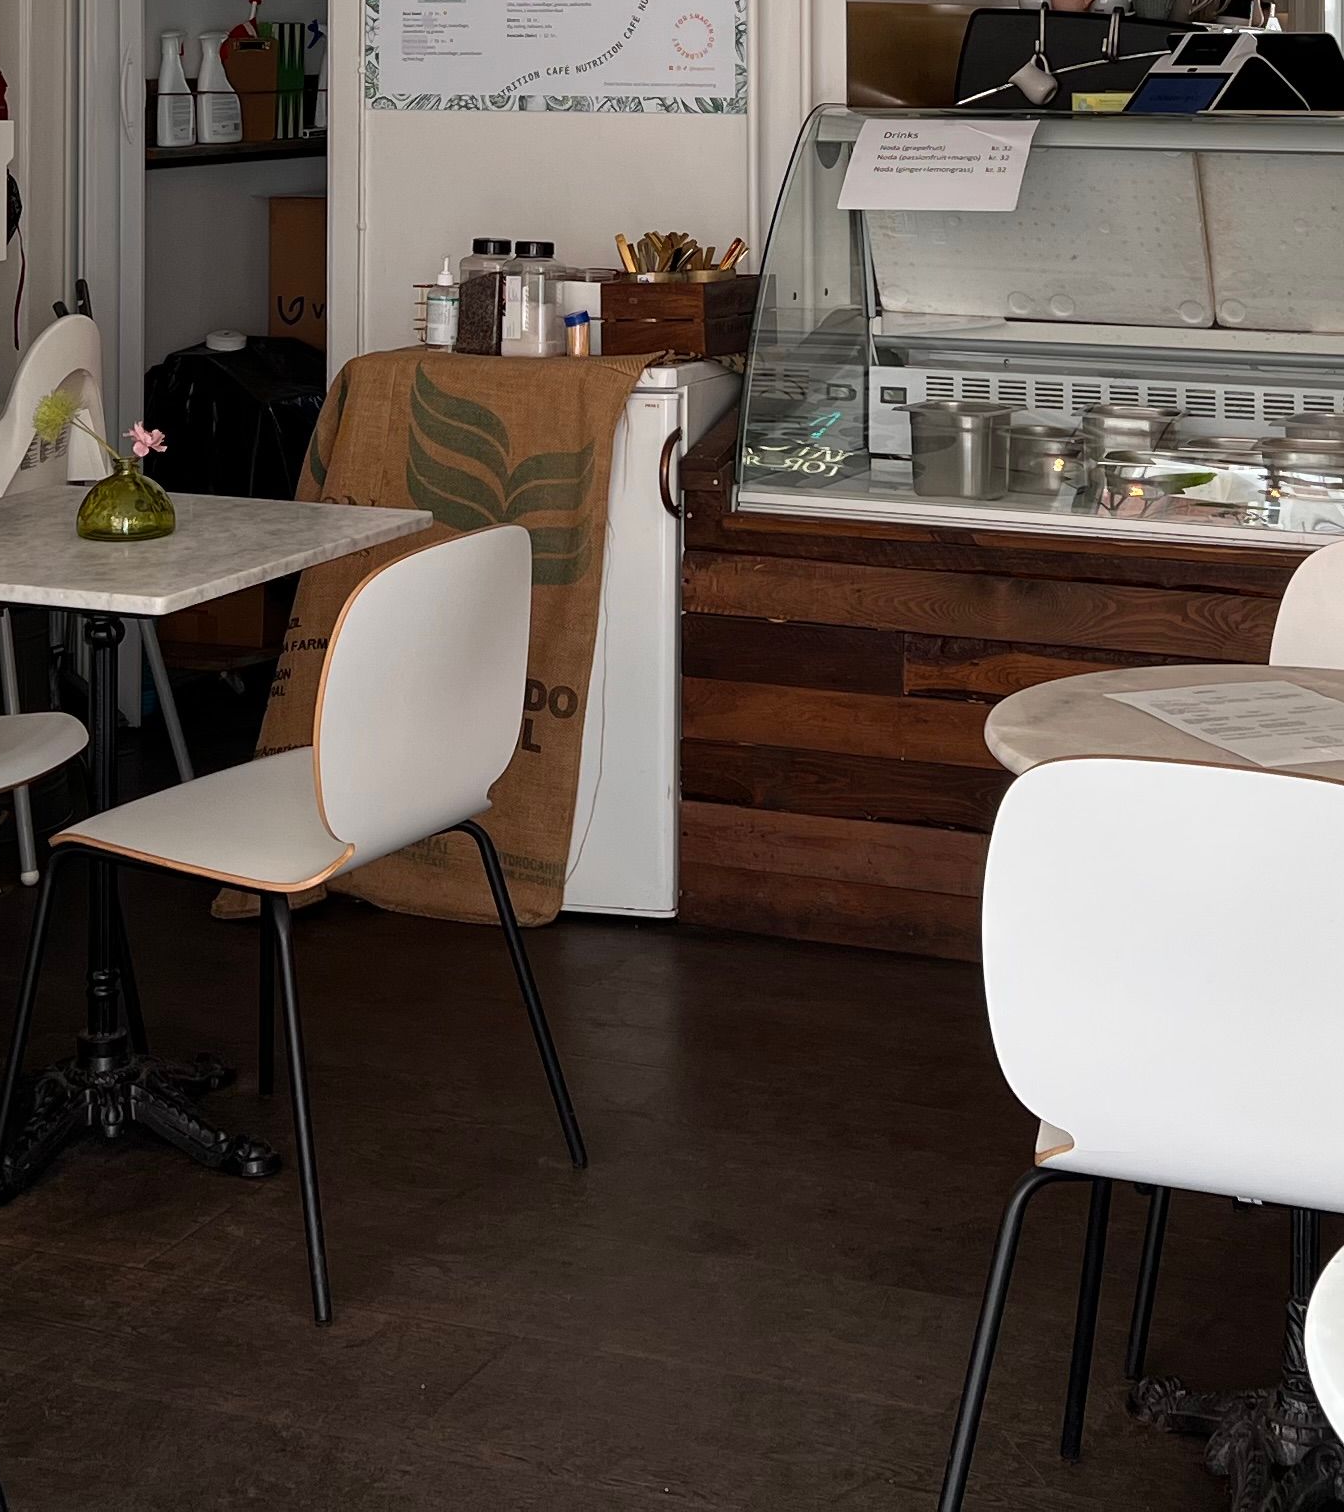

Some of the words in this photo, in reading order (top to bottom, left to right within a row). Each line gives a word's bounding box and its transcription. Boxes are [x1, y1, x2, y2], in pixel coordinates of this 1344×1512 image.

[546, 64, 570, 76] CAFÉ
[576, 41, 624, 73] NUTRITION
[624, 15, 641, 40] CAFÉ
